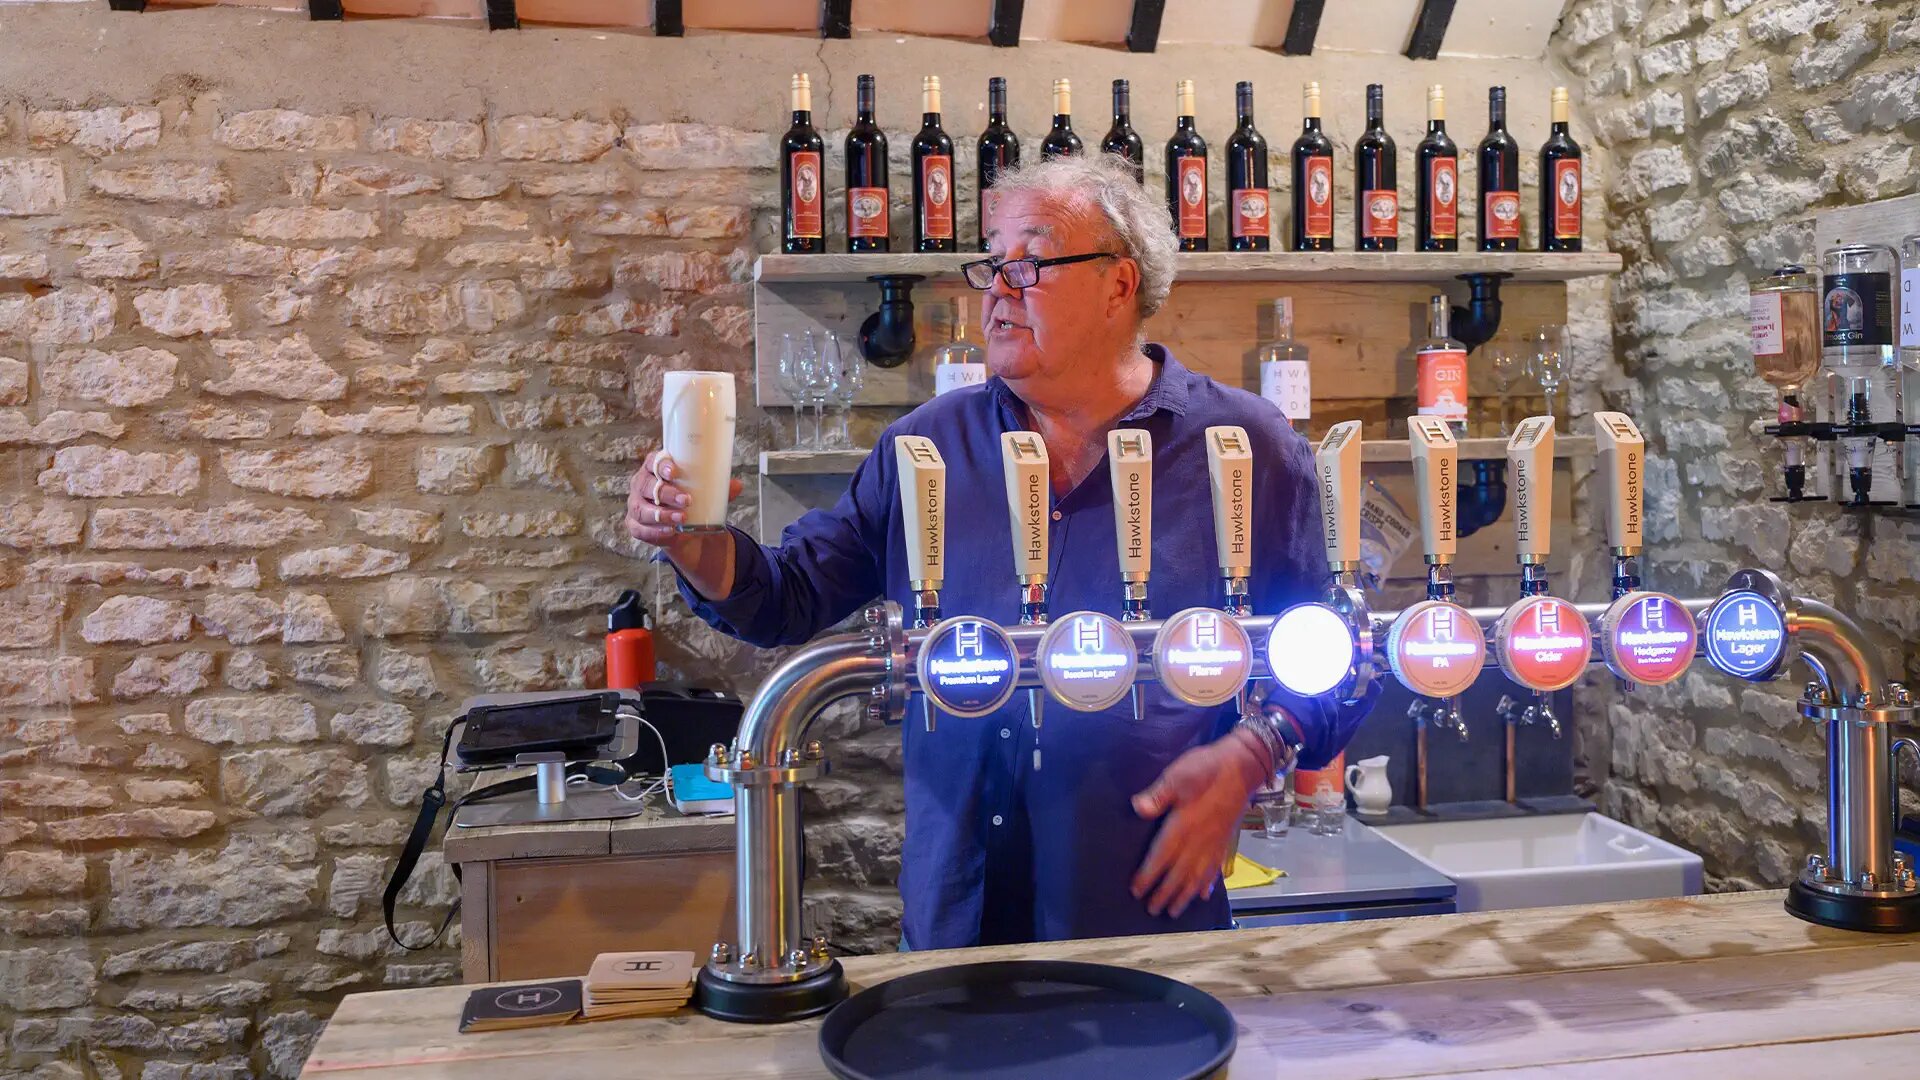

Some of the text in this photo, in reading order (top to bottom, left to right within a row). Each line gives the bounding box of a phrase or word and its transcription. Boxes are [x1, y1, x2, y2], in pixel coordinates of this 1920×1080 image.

[1847, 331, 1863, 340] Gin
[1434, 369, 1461, 381] GIN
[1438, 458, 1452, 542] Hawkstone
[1516, 459, 1529, 541] Hawkstone
[1626, 452, 1638, 534] Hawkstone
[1230, 469, 1245, 554] Hawkstone
[1324, 465, 1337, 549] Hawkstone
[1027, 474, 1042, 561] Hawkstone
[1127, 472, 1142, 558] Hawkstone
[926, 479, 939, 566] Hawkstone
[1716, 628, 1780, 642] Hawkstone
[1633, 646, 1677, 657] Hedgerow
[1731, 642, 1766, 656] Lager
[1432, 656, 1450, 668] IPA
[1535, 651, 1563, 663] Cider
[977, 674, 1001, 685] Lager
[1094, 669, 1116, 679] Lager
